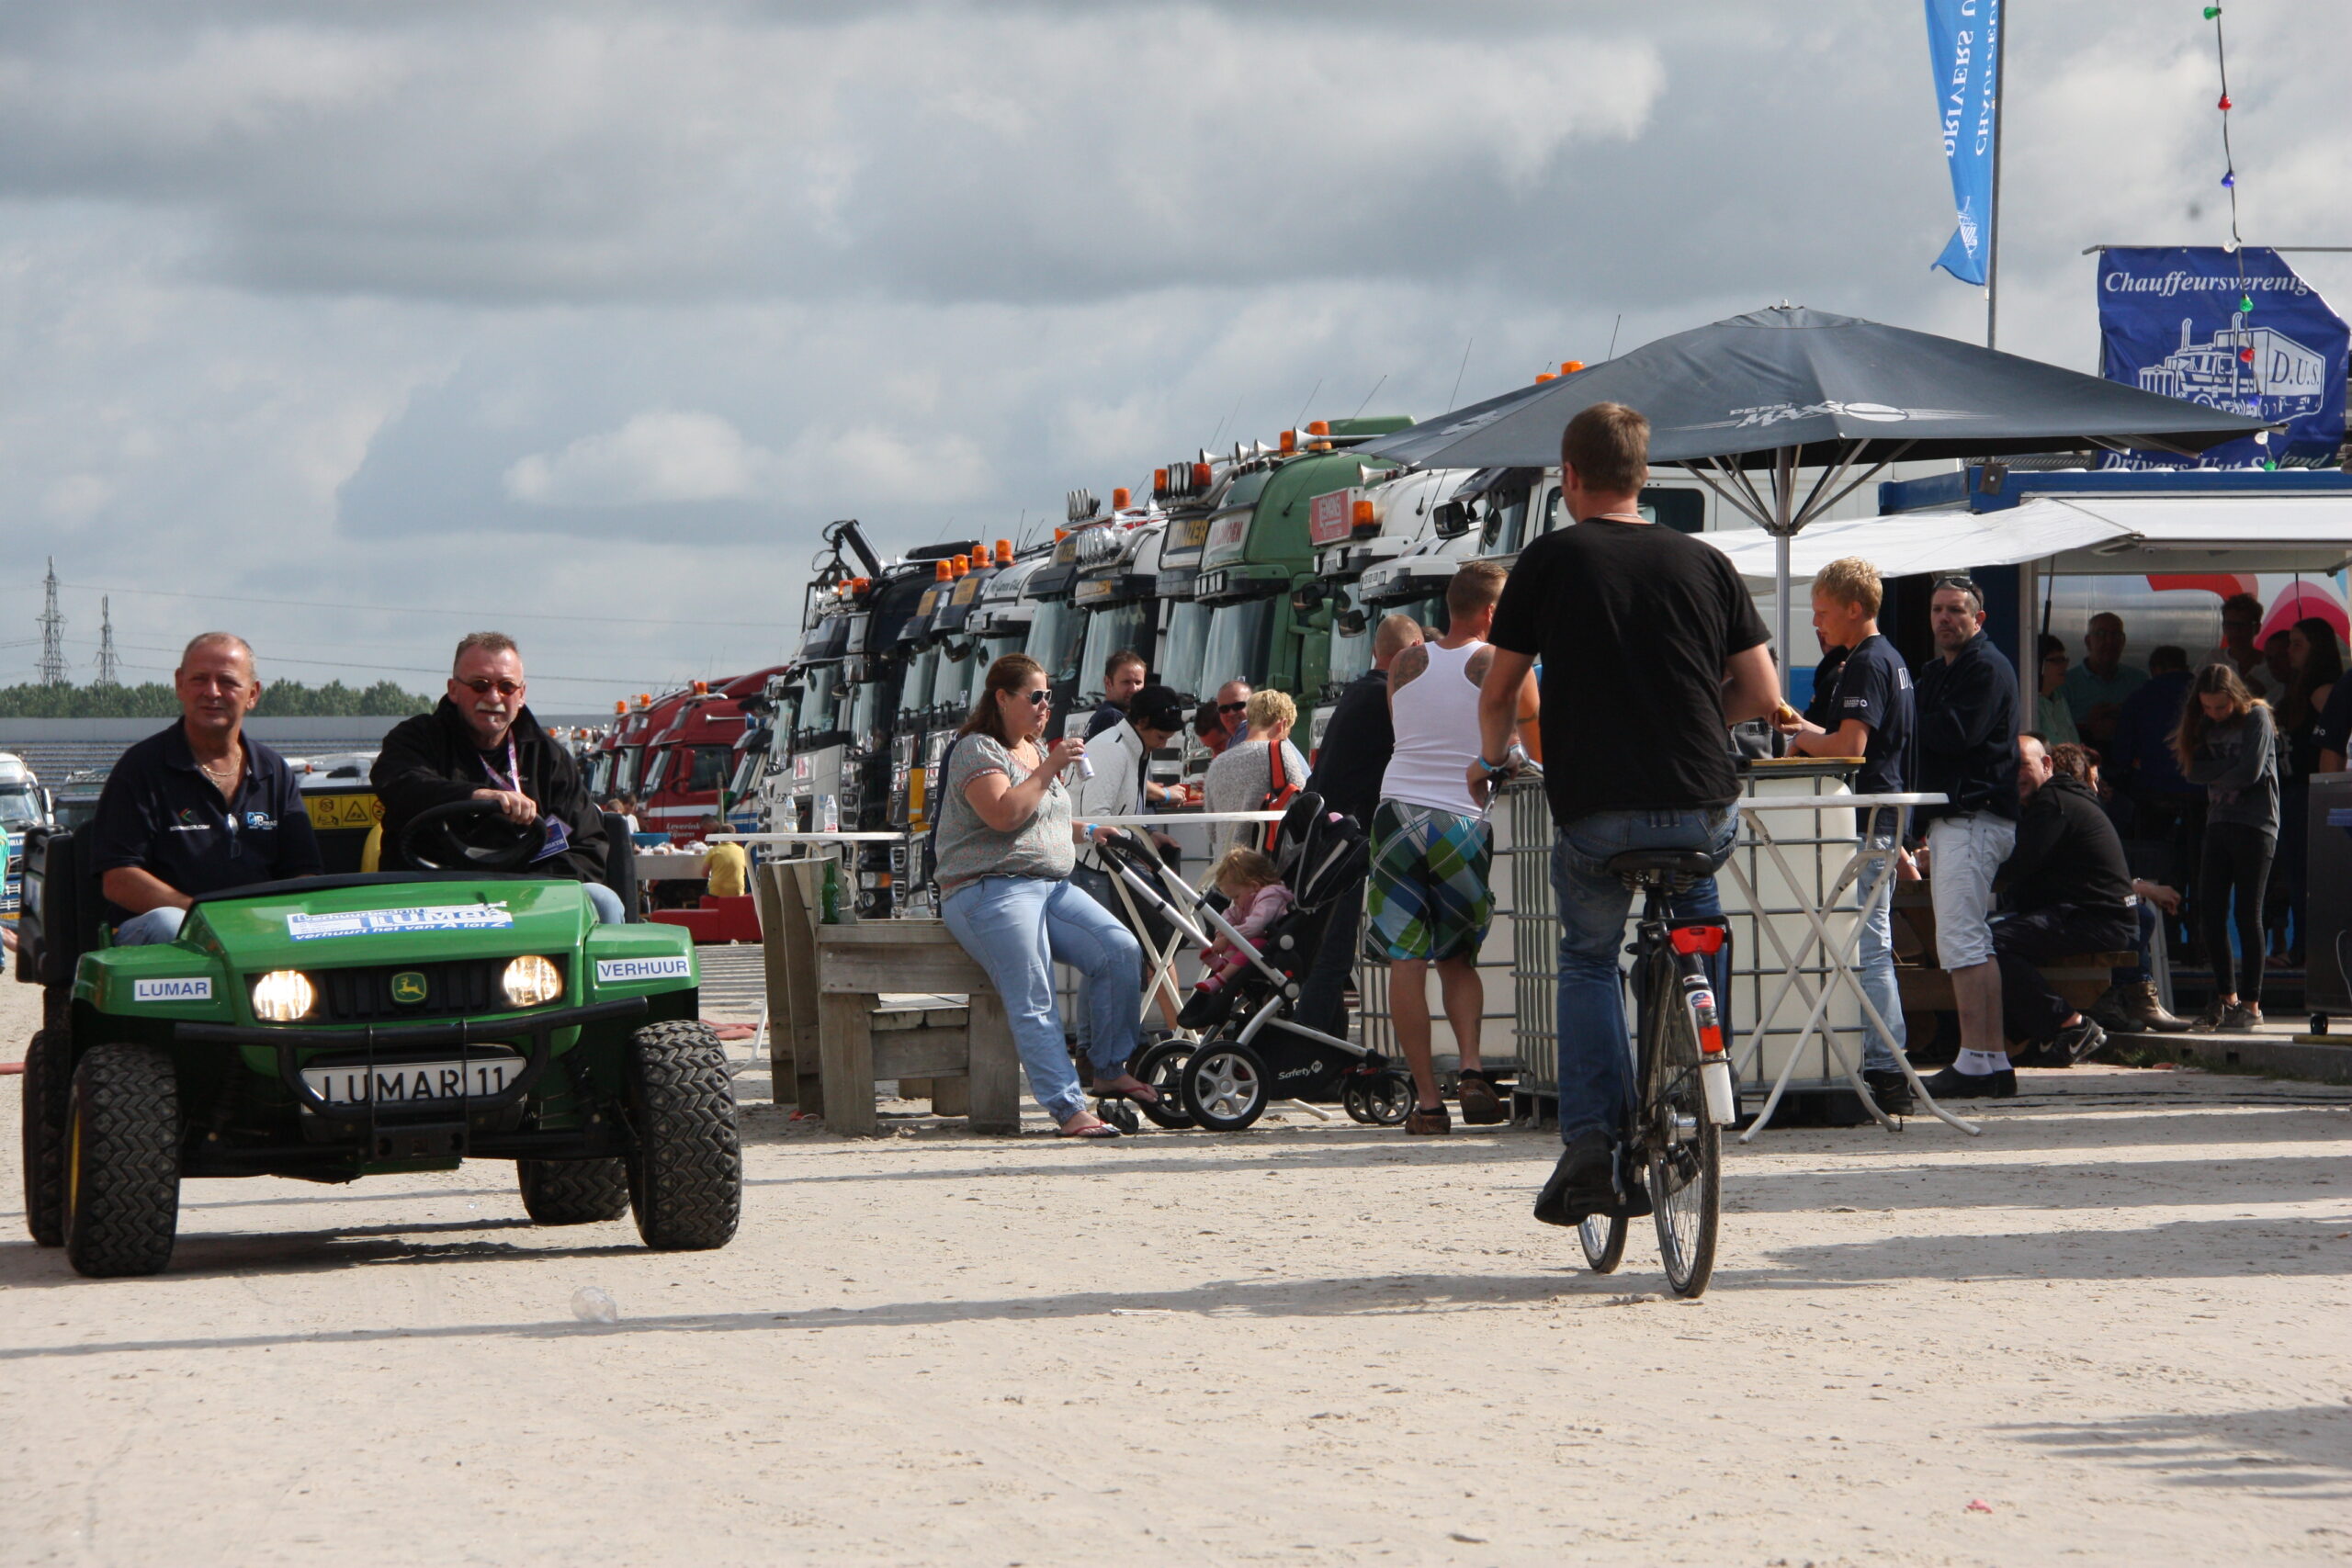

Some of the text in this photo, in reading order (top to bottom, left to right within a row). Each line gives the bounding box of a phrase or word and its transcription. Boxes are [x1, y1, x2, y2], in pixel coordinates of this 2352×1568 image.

[2269, 349, 2320, 386] D.U.S.
[1729, 402, 1794, 416] PEPSI
[295, 929, 368, 940] verhuurt
[600, 960, 688, 977] VERHUUR
[139, 982, 208, 997] LUMAR
[1278, 1067, 1311, 1080] Safety
[323, 1066, 503, 1103] LUMAR 11
